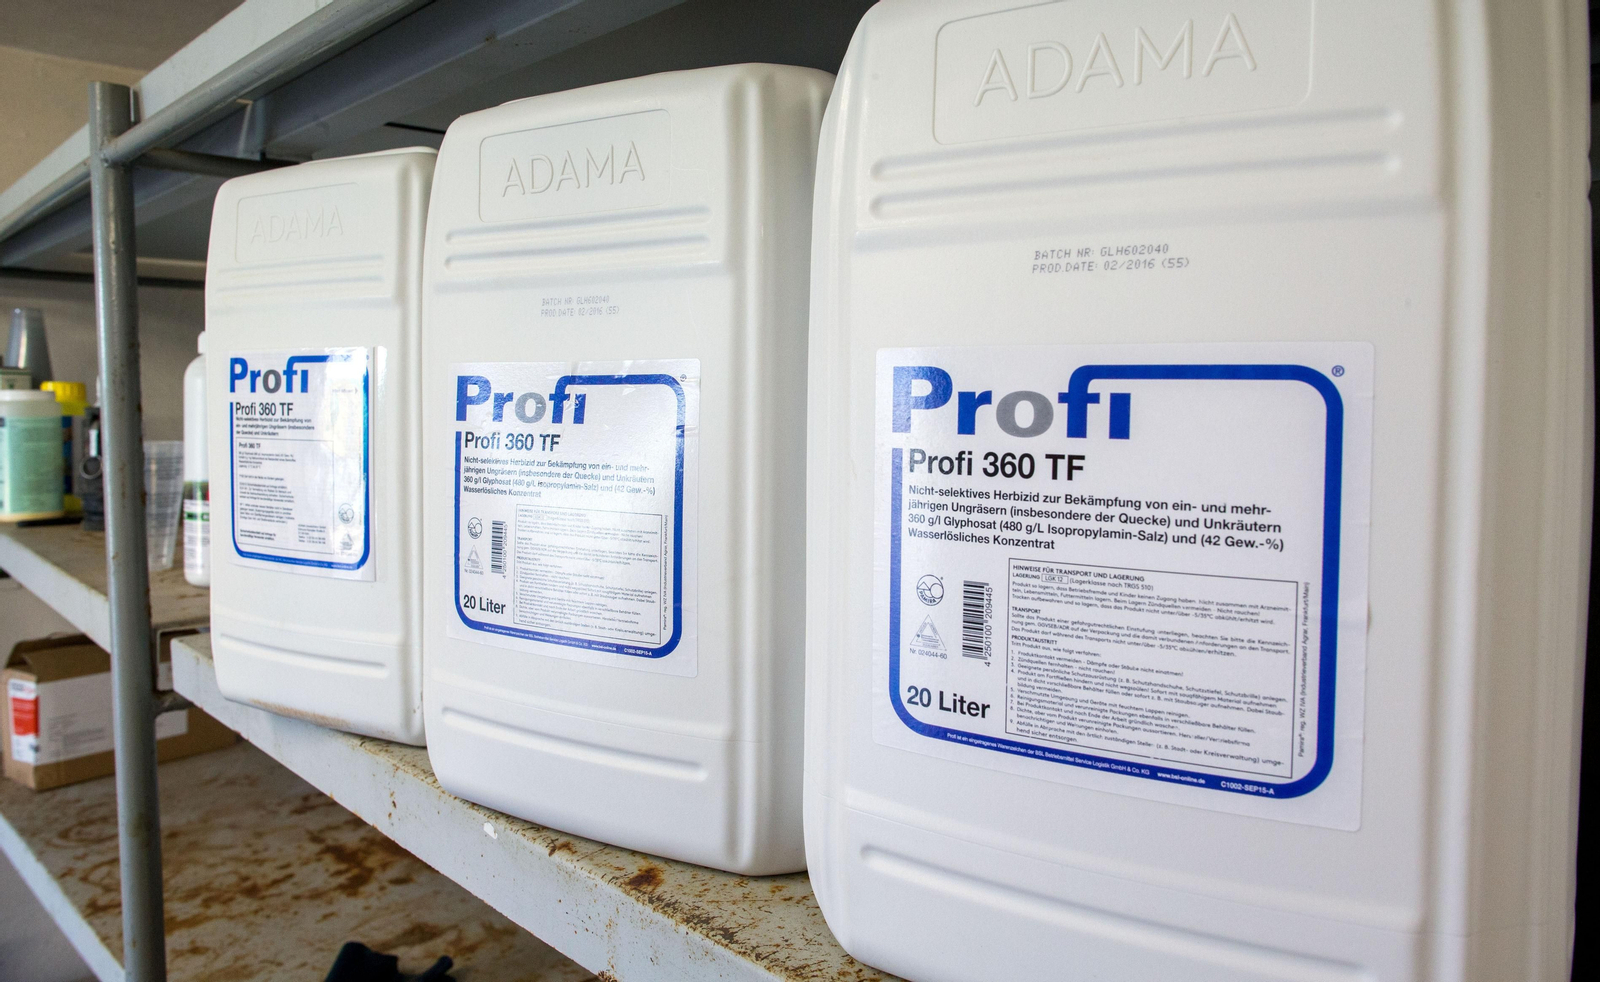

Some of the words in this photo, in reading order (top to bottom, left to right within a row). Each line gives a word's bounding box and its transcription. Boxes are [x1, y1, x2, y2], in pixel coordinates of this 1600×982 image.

[972, 12, 1258, 107] ADAMA
[501, 139, 646, 198] ADAMA
[249, 204, 343, 245] ADAMA
[1034, 249, 1071, 260] BATCH
[1077, 248, 1095, 258] NR:
[1100, 243, 1169, 257] GLH602040
[1032, 261, 1098, 274] PROD.DATE:
[1103, 258, 1156, 271] 02/2016
[1161, 257, 1190, 269] (55)
[541, 297, 562, 306] BATCH
[229, 356, 309, 394] Profi
[235, 402, 256, 416] Profi
[258, 402, 277, 416] 360
[279, 402, 293, 416] TF
[455, 375, 587, 425] Profi
[892, 364, 1131, 440] Profi
[464, 431, 500, 450] Profi
[504, 433, 534, 451] 360
[540, 434, 561, 451] TF
[464, 455, 508, 464] Nicht-selektives
[510, 457, 535, 466] Herbizid
[548, 459, 587, 470] Bekämpfung
[616, 462, 628, 470] und
[630, 463, 649, 471] mehr-
[908, 448, 973, 477] Profi
[982, 452, 1035, 480] 360
[1045, 454, 1086, 482] TF
[464, 466, 486, 476] jährigen
[487, 467, 517, 477] Ungräsern
[518, 469, 561, 478] (insbesondere
[574, 471, 601, 481] Quecke)
[616, 473, 654, 482] Unkräutern
[463, 485, 507, 495] Wasserlösliches
[509, 487, 541, 497] Konzentrat
[909, 484, 990, 499] Nicht-selektives
[994, 488, 1039, 502] Herbizid
[1043, 494, 1061, 503] zur
[1065, 492, 1141, 511] Bekämpfung
[1146, 499, 1168, 510] von
[1172, 498, 1197, 511] ein-
[1202, 500, 1226, 513] und
[1231, 502, 1271, 516] mehr-
[908, 499, 948, 514] jährigen
[952, 502, 1007, 516] Ungräsern
[1010, 505, 1091, 522] (insbesondere
[1095, 510, 1115, 523] der
[1119, 512, 1171, 529] Quecke)
[1175, 515, 1199, 528] und
[1204, 516, 1281, 532] Unkräutern
[908, 513, 925, 525] 360
[928, 515, 941, 528] g/l
[944, 516, 997, 531] Glyphosat
[1000, 519, 1022, 532] (480
[1026, 521, 1044, 535] g/L
[1048, 522, 1168, 544] Isopropylamin-Salz)
[1172, 531, 1197, 544] und
[1201, 532, 1220, 547] (42
[1225, 533, 1284, 552] Gew.-%)
[908, 527, 990, 543] Wasserlösliches
[993, 533, 1055, 549] Konzentrat
[1013, 565, 1041, 573] HINWEISE
[1043, 566, 1054, 574] FÜR
[1056, 568, 1092, 577] TRANSPORT
[1109, 573, 1145, 582] LAGERUNG
[463, 594, 477, 610] 20
[479, 597, 506, 615] Liter
[985, 587, 993, 619] 209445
[1012, 607, 1041, 615] TRANSPORT
[984, 625, 993, 657] 250100
[1012, 635, 1057, 646] PRODUKTAUSTRITT
[907, 685, 931, 708] 20
[939, 691, 990, 719] Liter
[1031, 730, 1047, 738] sicher
[1049, 734, 1078, 743] entsorgen.
[1221, 780, 1274, 795] C1002-SEP15-A
